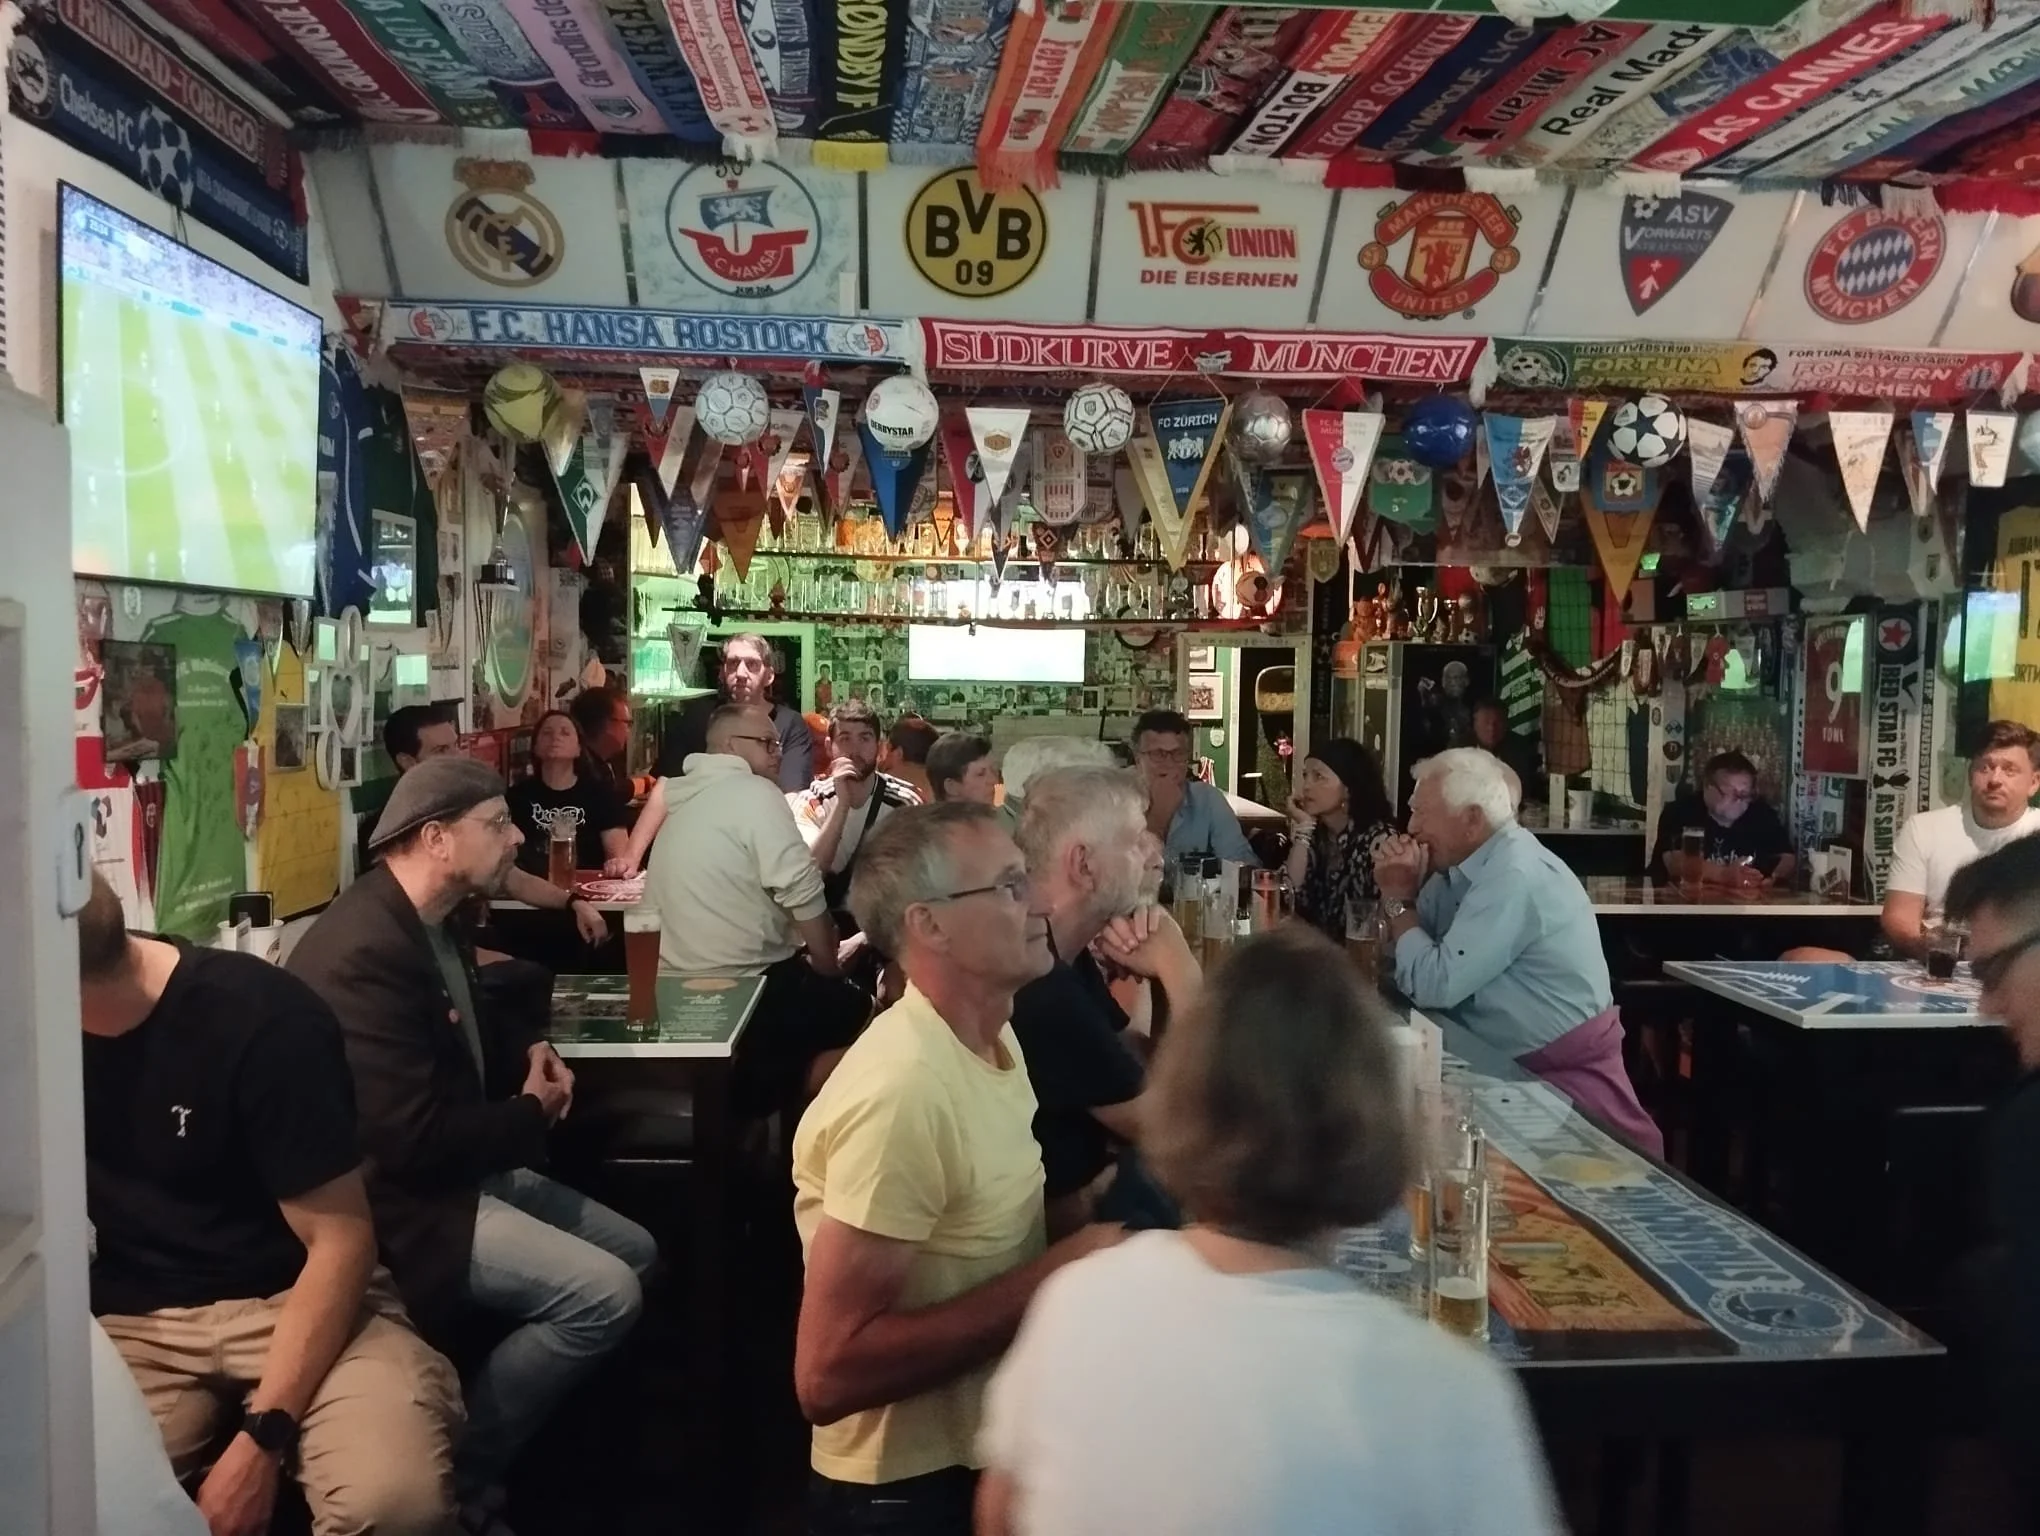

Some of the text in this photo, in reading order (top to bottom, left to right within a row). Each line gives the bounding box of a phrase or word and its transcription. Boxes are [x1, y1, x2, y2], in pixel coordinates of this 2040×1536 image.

[549, 19, 615, 89] Girondins
[1023, 38, 1083, 100] Ferrari
[1490, 23, 1623, 123] AC Milan
[1697, 114, 1761, 145] AS
[1745, 21, 1927, 111] CANNES
[59, 73, 136, 152] Chelsea FC
[835, 92, 881, 108] IF
[1247, 80, 1329, 148] BOLTON
[1540, 85, 1626, 137] Real
[1314, 97, 1389, 146] HOPP
[925, 179, 1032, 260] BVB
[1387, 193, 1507, 238] MANCHESTER
[1665, 203, 1720, 225] ASV
[1226, 226, 1297, 258] UNION
[1821, 226, 1856, 256] FC
[728, 249, 778, 279] HANSA
[955, 259, 994, 286] 09
[1140, 268, 1298, 288] DIE EISERNEN
[1391, 289, 1469, 311] UNITED
[468, 309, 831, 353] F.C. HANSA ROSTOCK
[944, 329, 1461, 379] SÜDKURVE MÜNCHEN
[1573, 357, 1722, 375] FORTUNA
[1788, 349, 1852, 358] FORTUNA
[1853, 350, 1911, 364] SITTARD
[1793, 361, 1953, 382] FC BAYERN
[870, 419, 915, 437] DERBYSTAR
[1157, 413, 1218, 428] FC ZÜRICH
[1825, 661, 1844, 724] 9
[1879, 666, 1902, 698] RED
[1877, 702, 1899, 744] STAR
[1918, 668, 1933, 812] GIF SUNDSVALL
[1877, 747, 1898, 767] FC
[1875, 794, 1895, 815] AS
[1580, 1186, 1802, 1285] STRASBOURG
